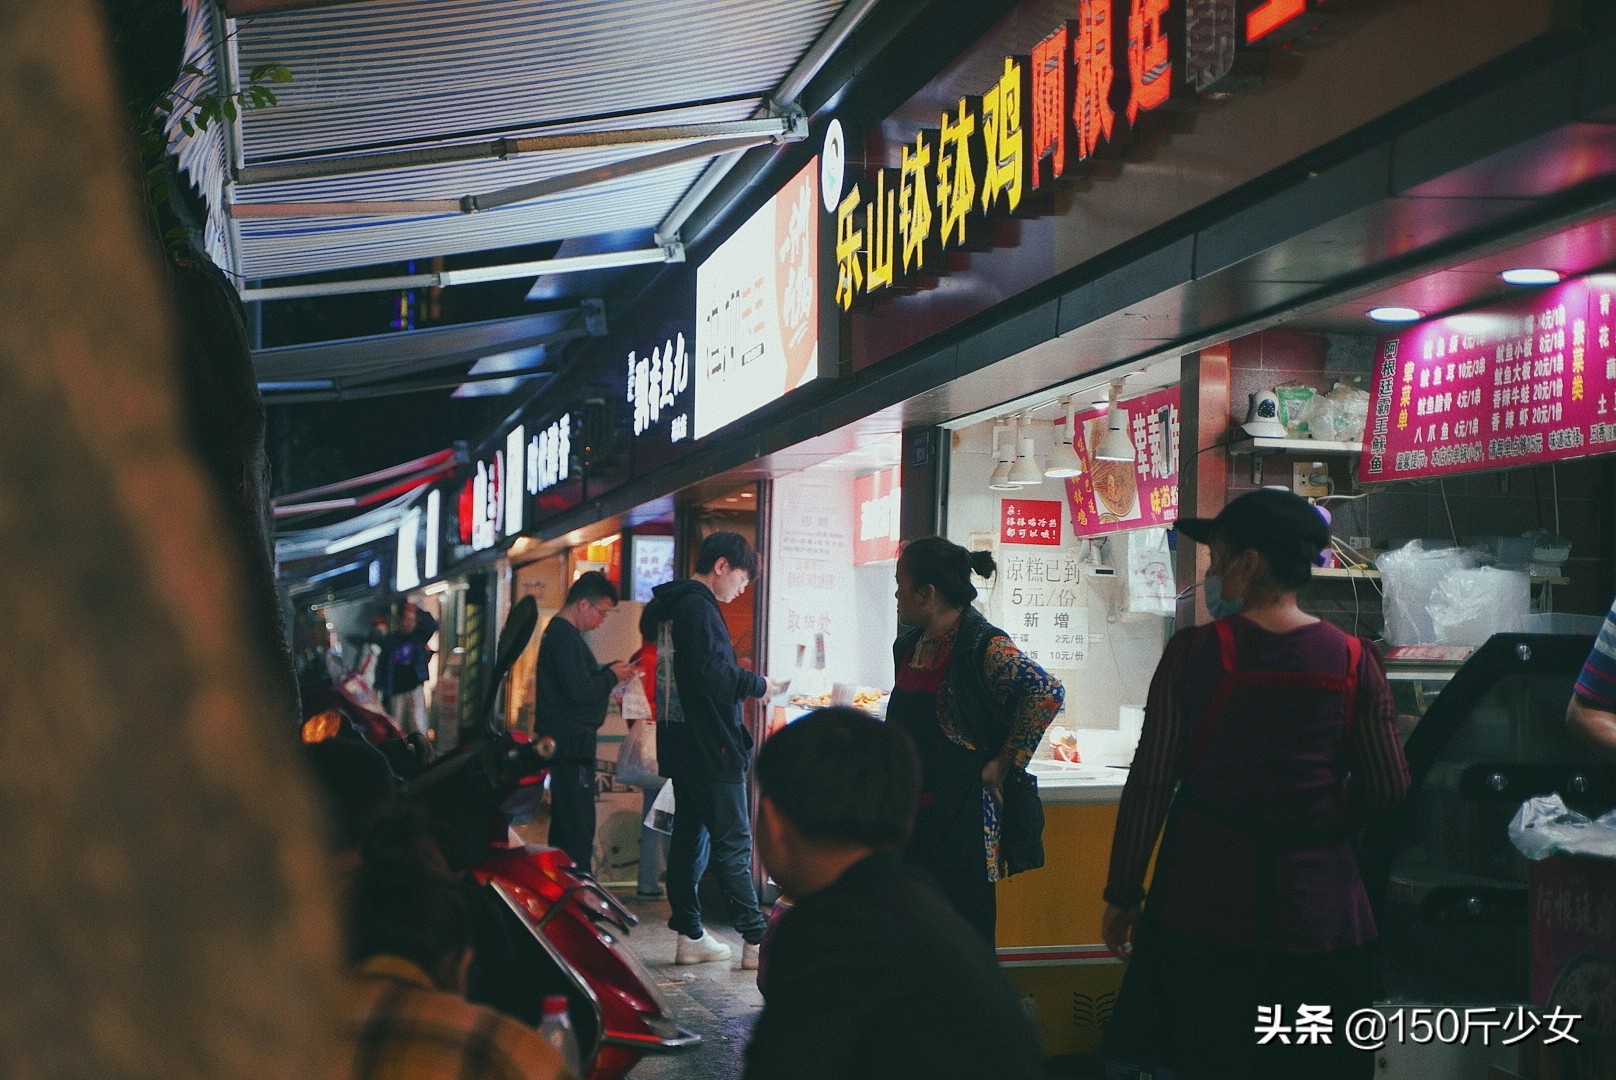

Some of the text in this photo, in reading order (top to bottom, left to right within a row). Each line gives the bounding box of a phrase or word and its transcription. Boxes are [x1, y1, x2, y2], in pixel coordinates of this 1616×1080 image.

[835, 55, 1023, 313] 乐山钵钵鸡
[1458, 356, 1486, 379] 10元/3串
[1534, 352, 1564, 377] 20元/1串
[1368, 338, 1399, 474] 阿根廷霸王鱿鱼
[1456, 387, 1481, 408] 4元/1串
[1492, 378, 1563, 409] 香辣牛蛙 20元/1份
[1491, 401, 1562, 432] 香辣虾 20元/1份
[1413, 417, 1479, 444] 八爪鱼 4元/1串
[1006, 556, 1080, 587] 凉糕已到
[1011, 588, 1077, 608] 5元/份
[1023, 611, 1070, 629] 新增
[1055, 634, 1084, 644] 2元/份
[1050, 651, 1084, 661] 10元/份
